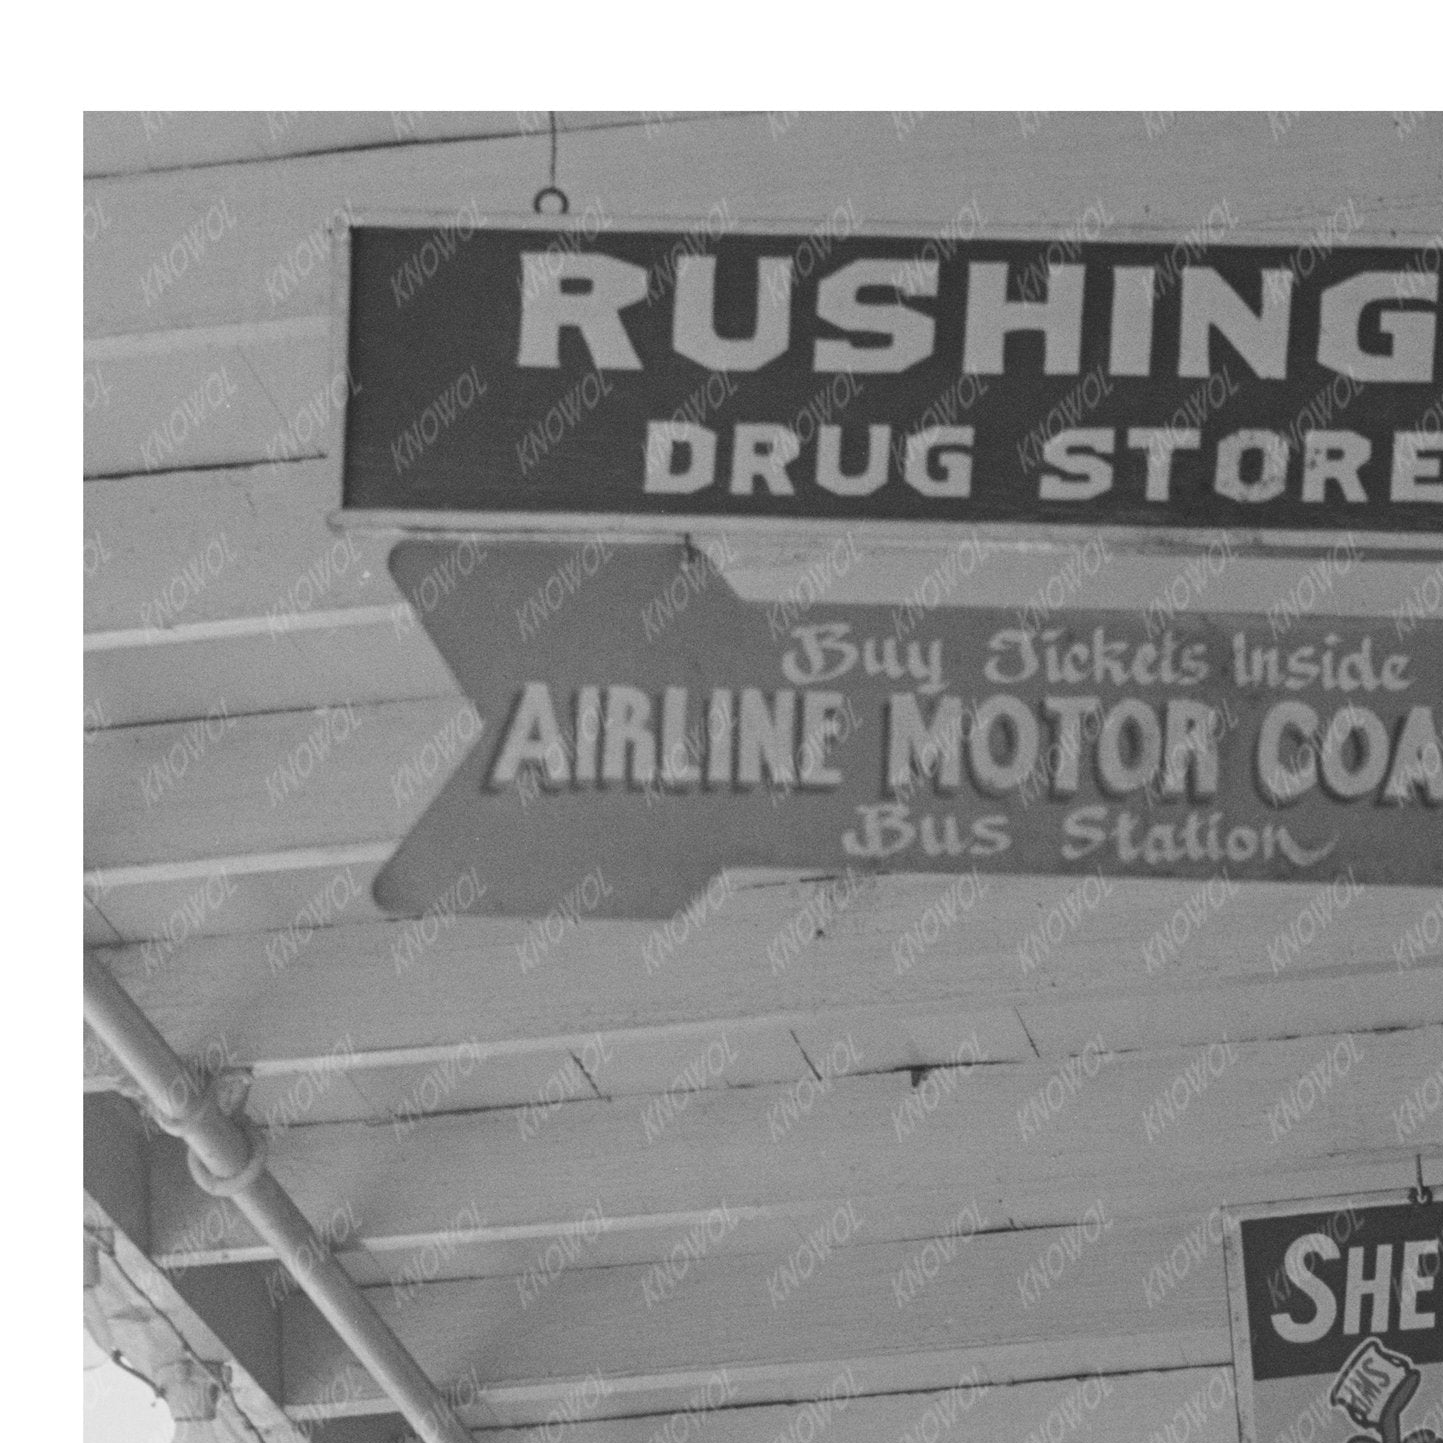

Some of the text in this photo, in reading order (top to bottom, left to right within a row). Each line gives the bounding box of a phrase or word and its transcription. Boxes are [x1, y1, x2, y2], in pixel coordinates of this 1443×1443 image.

[643, 420, 975, 496] DRUG
[781, 622, 1413, 693] Buy Tickets Inside
[489, 682, 842, 793] AIRLINE
[884, 690, 1219, 798] MOTOR
[841, 803, 1340, 866] Bus Station
